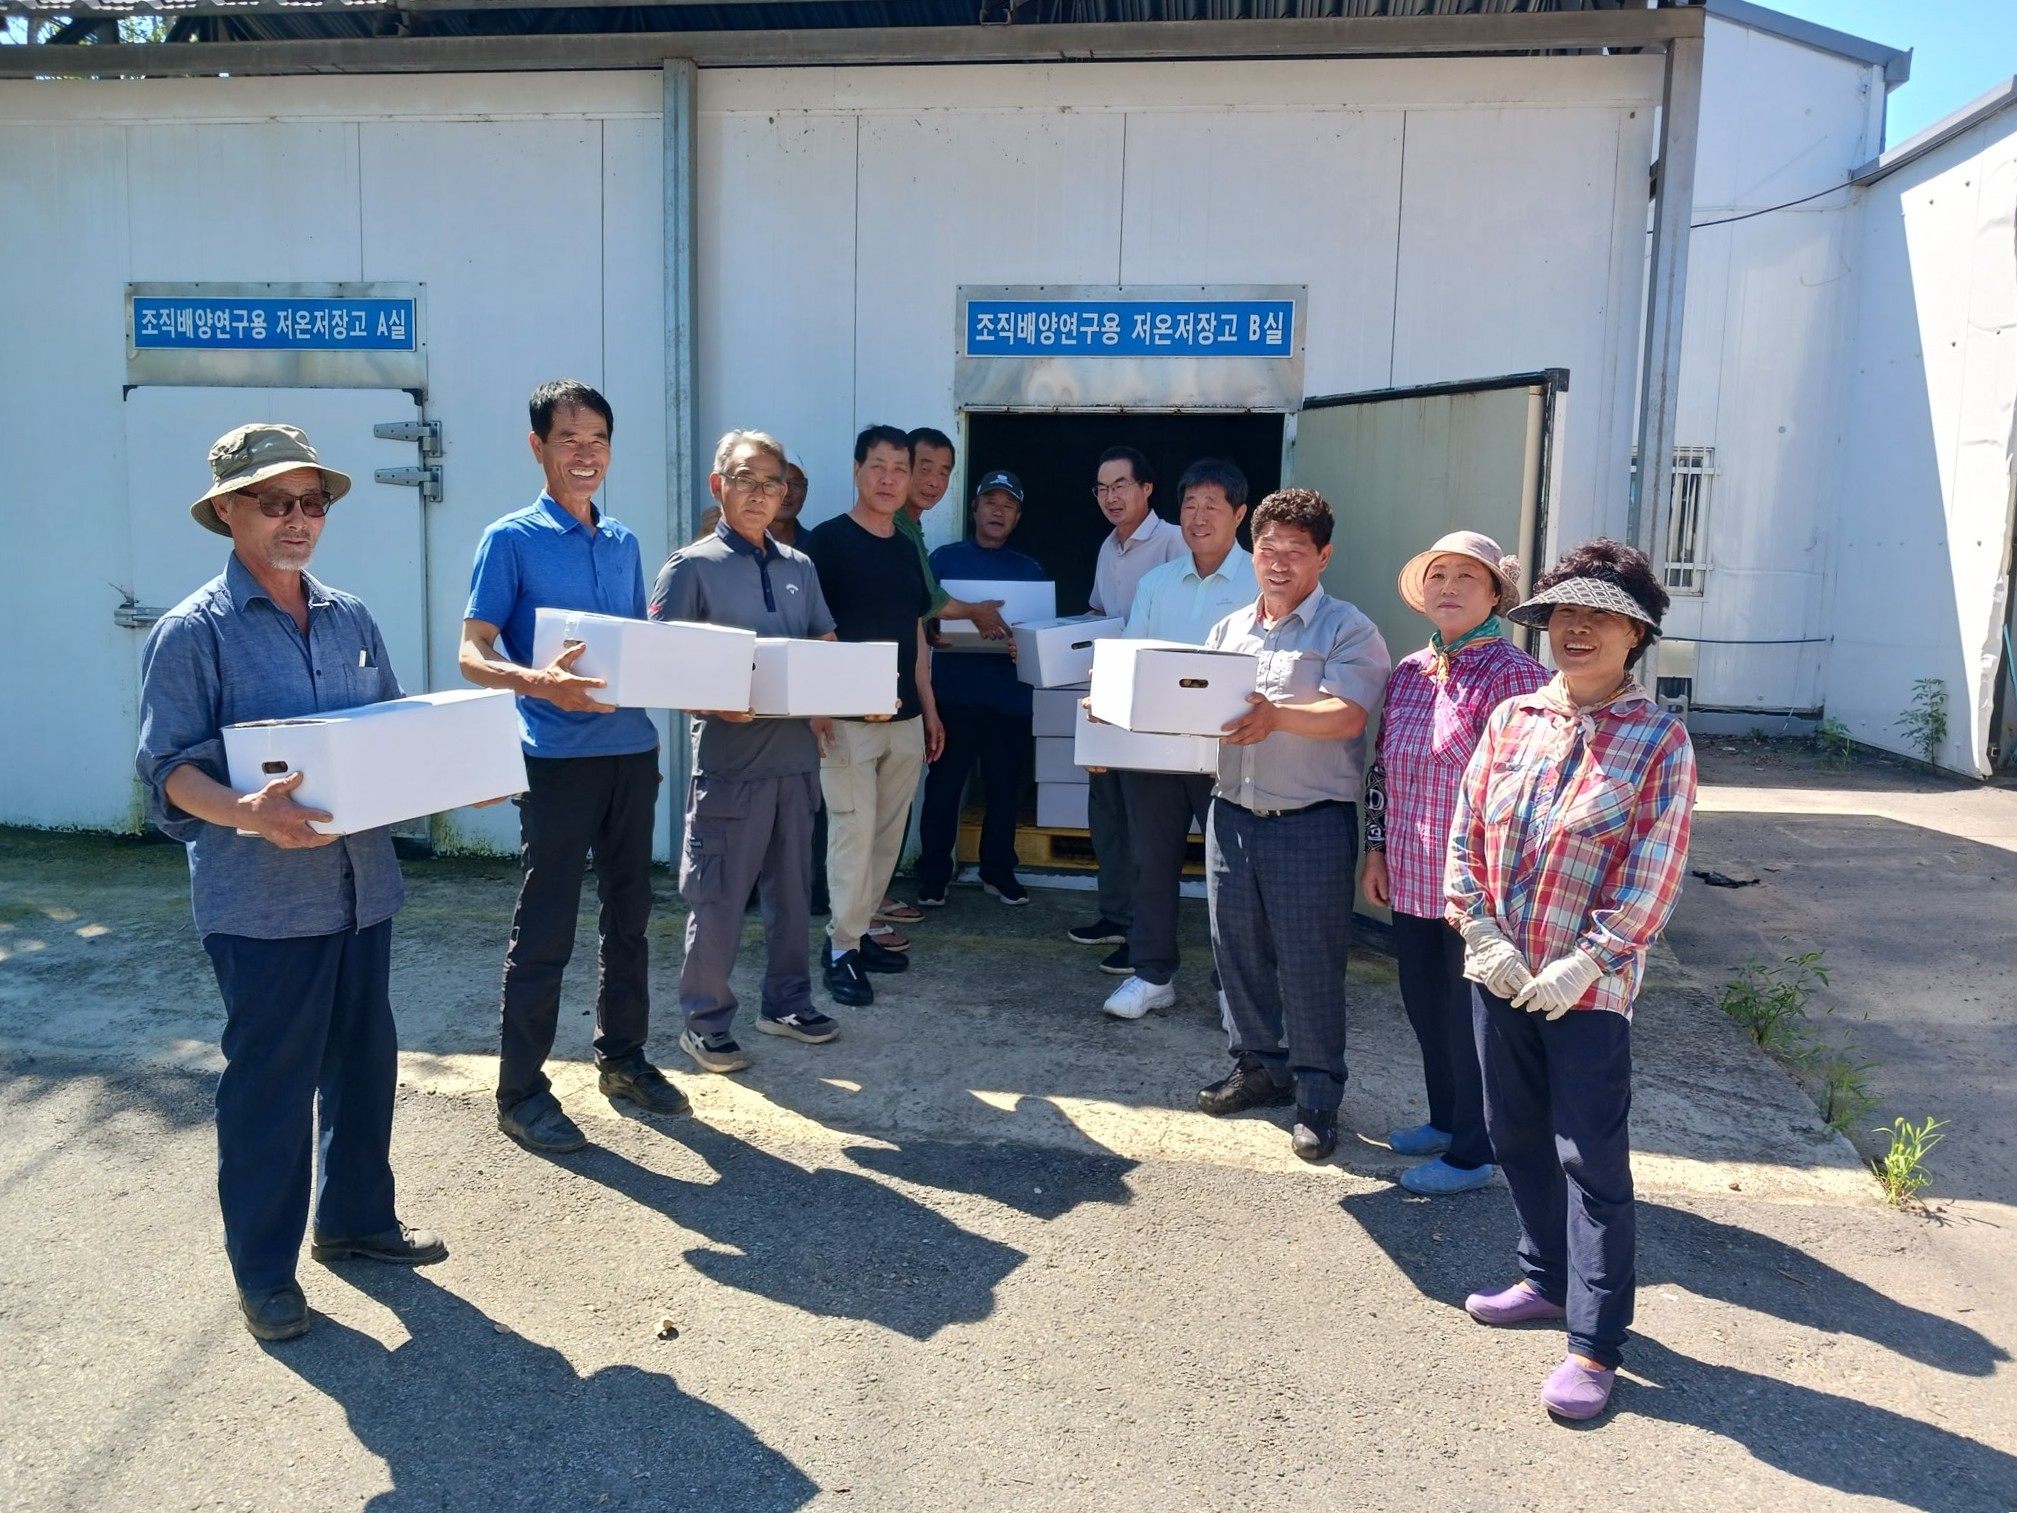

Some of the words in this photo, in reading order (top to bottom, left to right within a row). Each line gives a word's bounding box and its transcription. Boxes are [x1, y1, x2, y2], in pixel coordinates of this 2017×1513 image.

[142, 308, 267, 340] 조직배양연구용
[276, 308, 367, 340] 저온저장고
[376, 308, 406, 340] A실
[975, 311, 1121, 345] 조직배양연구용
[1131, 311, 1238, 345] 저온저장고
[1248, 311, 1284, 345] B실
